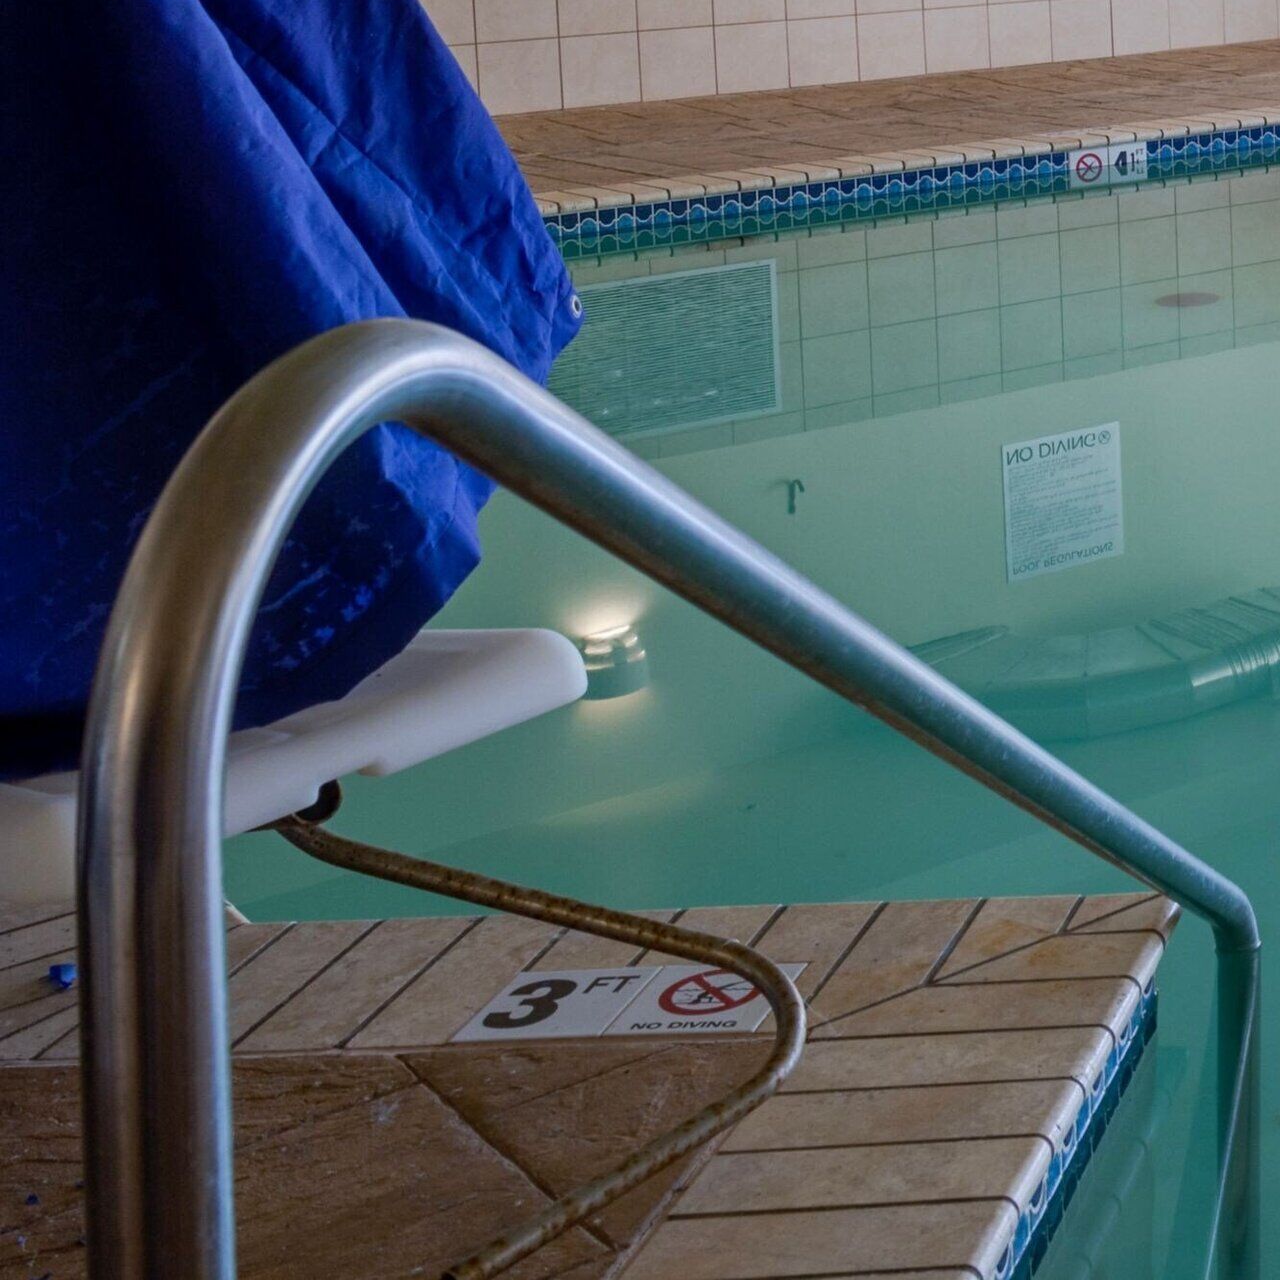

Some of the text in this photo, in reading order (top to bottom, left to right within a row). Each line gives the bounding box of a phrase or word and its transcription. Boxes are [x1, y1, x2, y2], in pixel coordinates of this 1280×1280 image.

[482, 975, 641, 1029] 3 FT
[630, 1020, 738, 1030] NO DIVING
